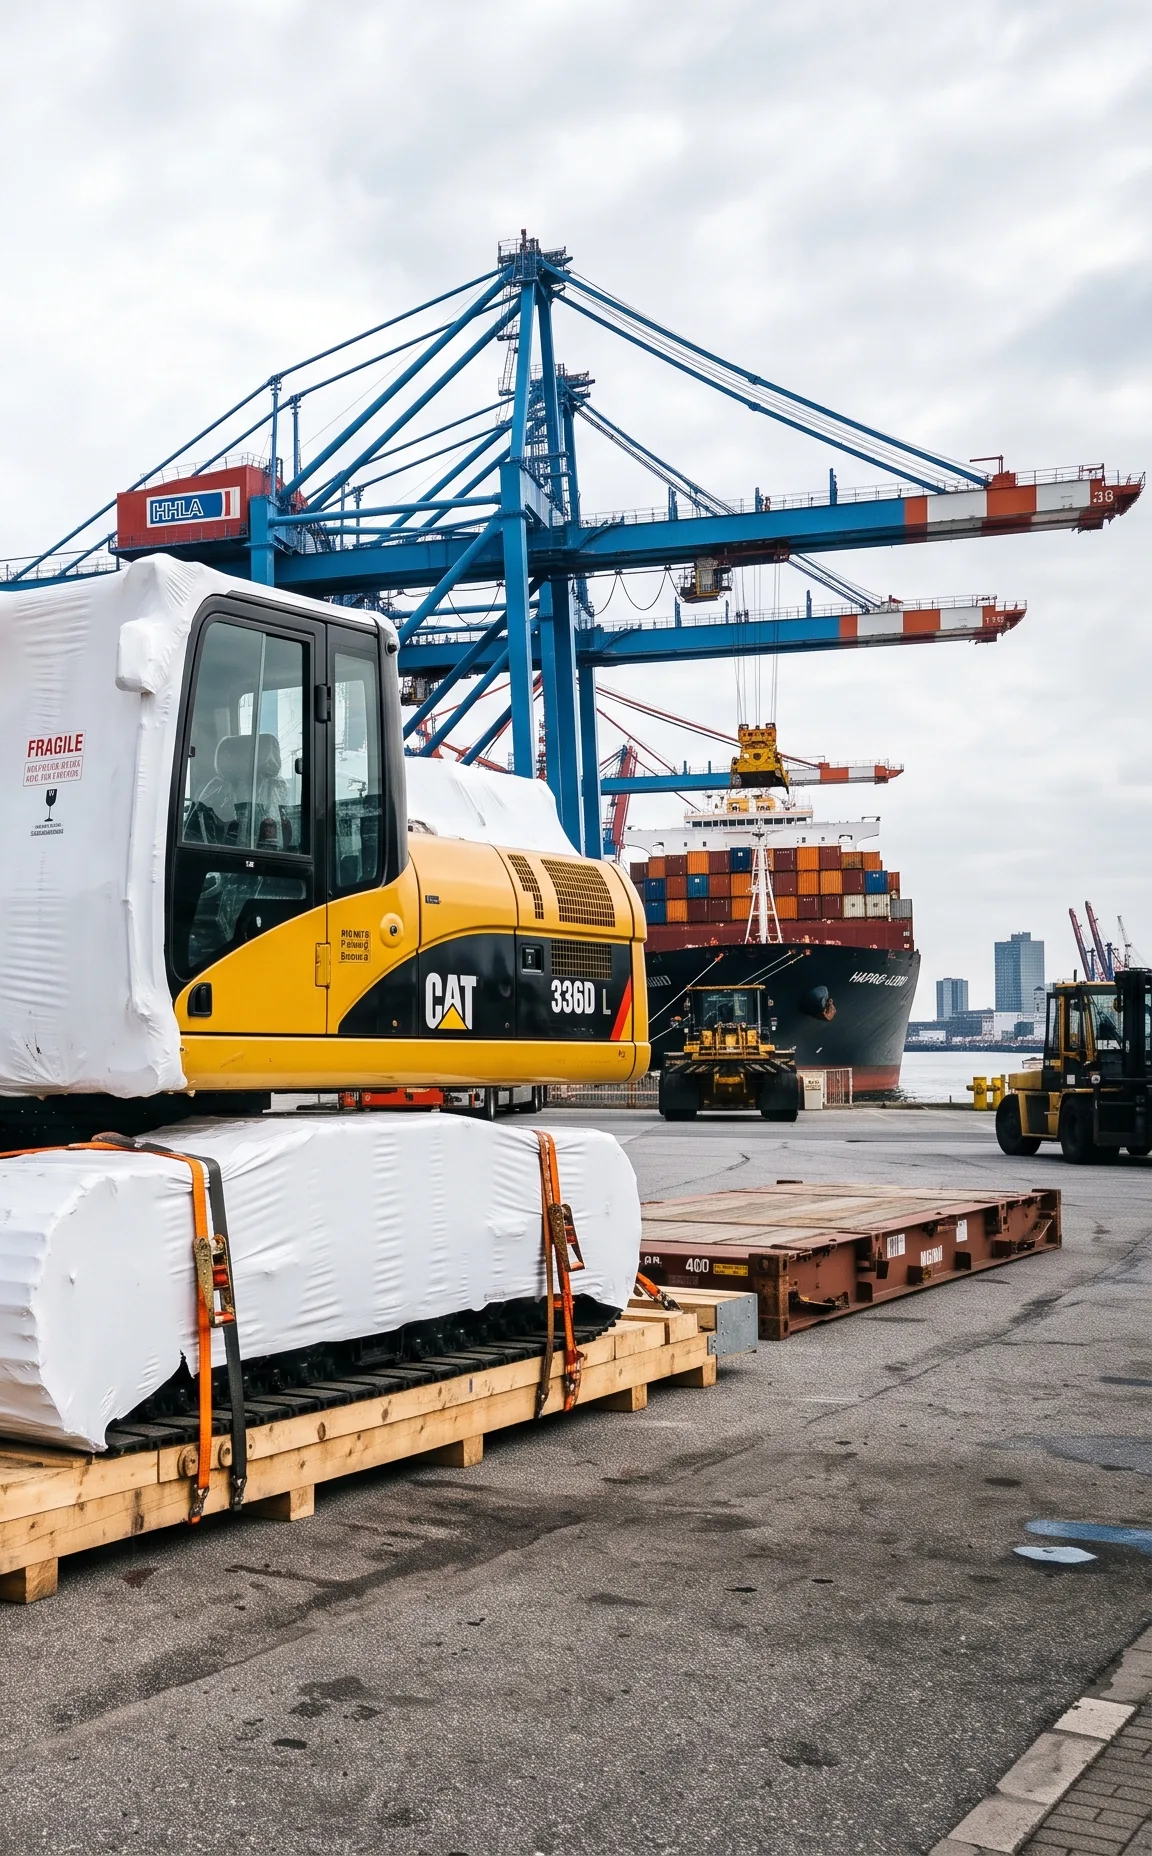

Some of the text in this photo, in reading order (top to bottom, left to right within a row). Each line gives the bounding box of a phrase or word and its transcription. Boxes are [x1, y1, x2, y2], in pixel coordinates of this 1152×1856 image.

[153, 499, 204, 521] HHLA
[27, 733, 84, 758] FRAGILE
[426, 972, 477, 1030] CAT
[551, 979, 612, 1015] 336D L
